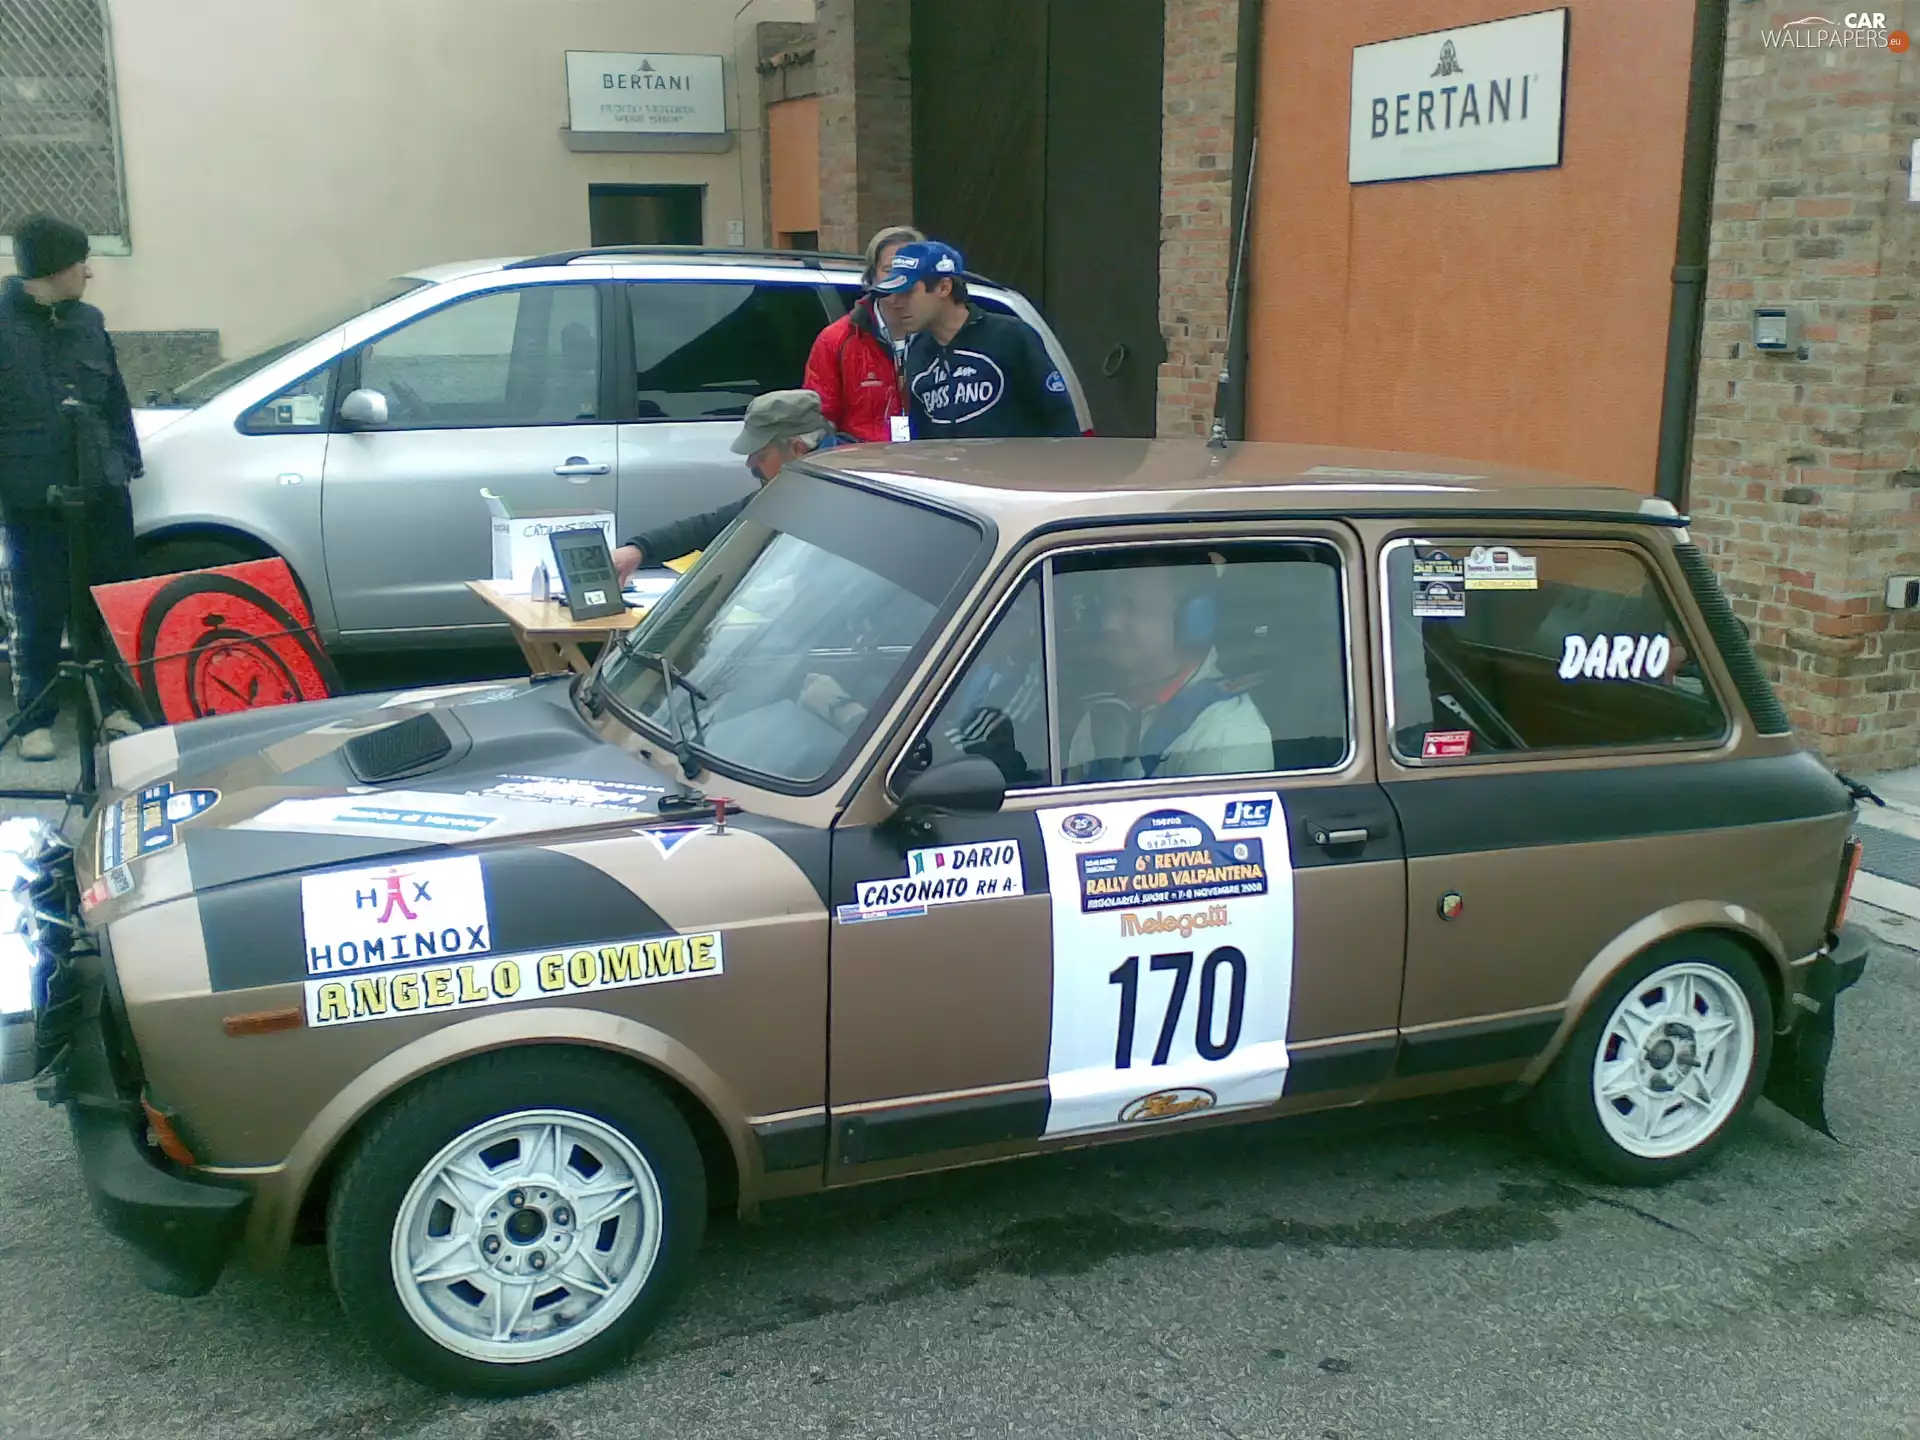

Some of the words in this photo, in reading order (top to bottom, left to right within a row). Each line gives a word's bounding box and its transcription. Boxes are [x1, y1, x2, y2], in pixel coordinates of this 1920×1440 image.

[602, 73, 691, 91] BERTANI
[1370, 74, 1530, 139] BERTANI
[1558, 633, 1671, 680] DARIO
[951, 845, 1015, 869] DARIO
[1154, 849, 1212, 870] REVIVAL
[864, 877, 969, 908] CASONATO
[976, 878, 998, 896] RH
[1086, 875, 1129, 896] RALLY
[1132, 872, 1169, 891] CLUB
[1171, 864, 1263, 886] VALPANTENA
[1120, 907, 1229, 939] Melegatti
[311, 924, 488, 971] HOMINOX
[317, 960, 523, 1023] ANGELO
[537, 935, 716, 993] GOMME
[1108, 945, 1248, 1070] 170
